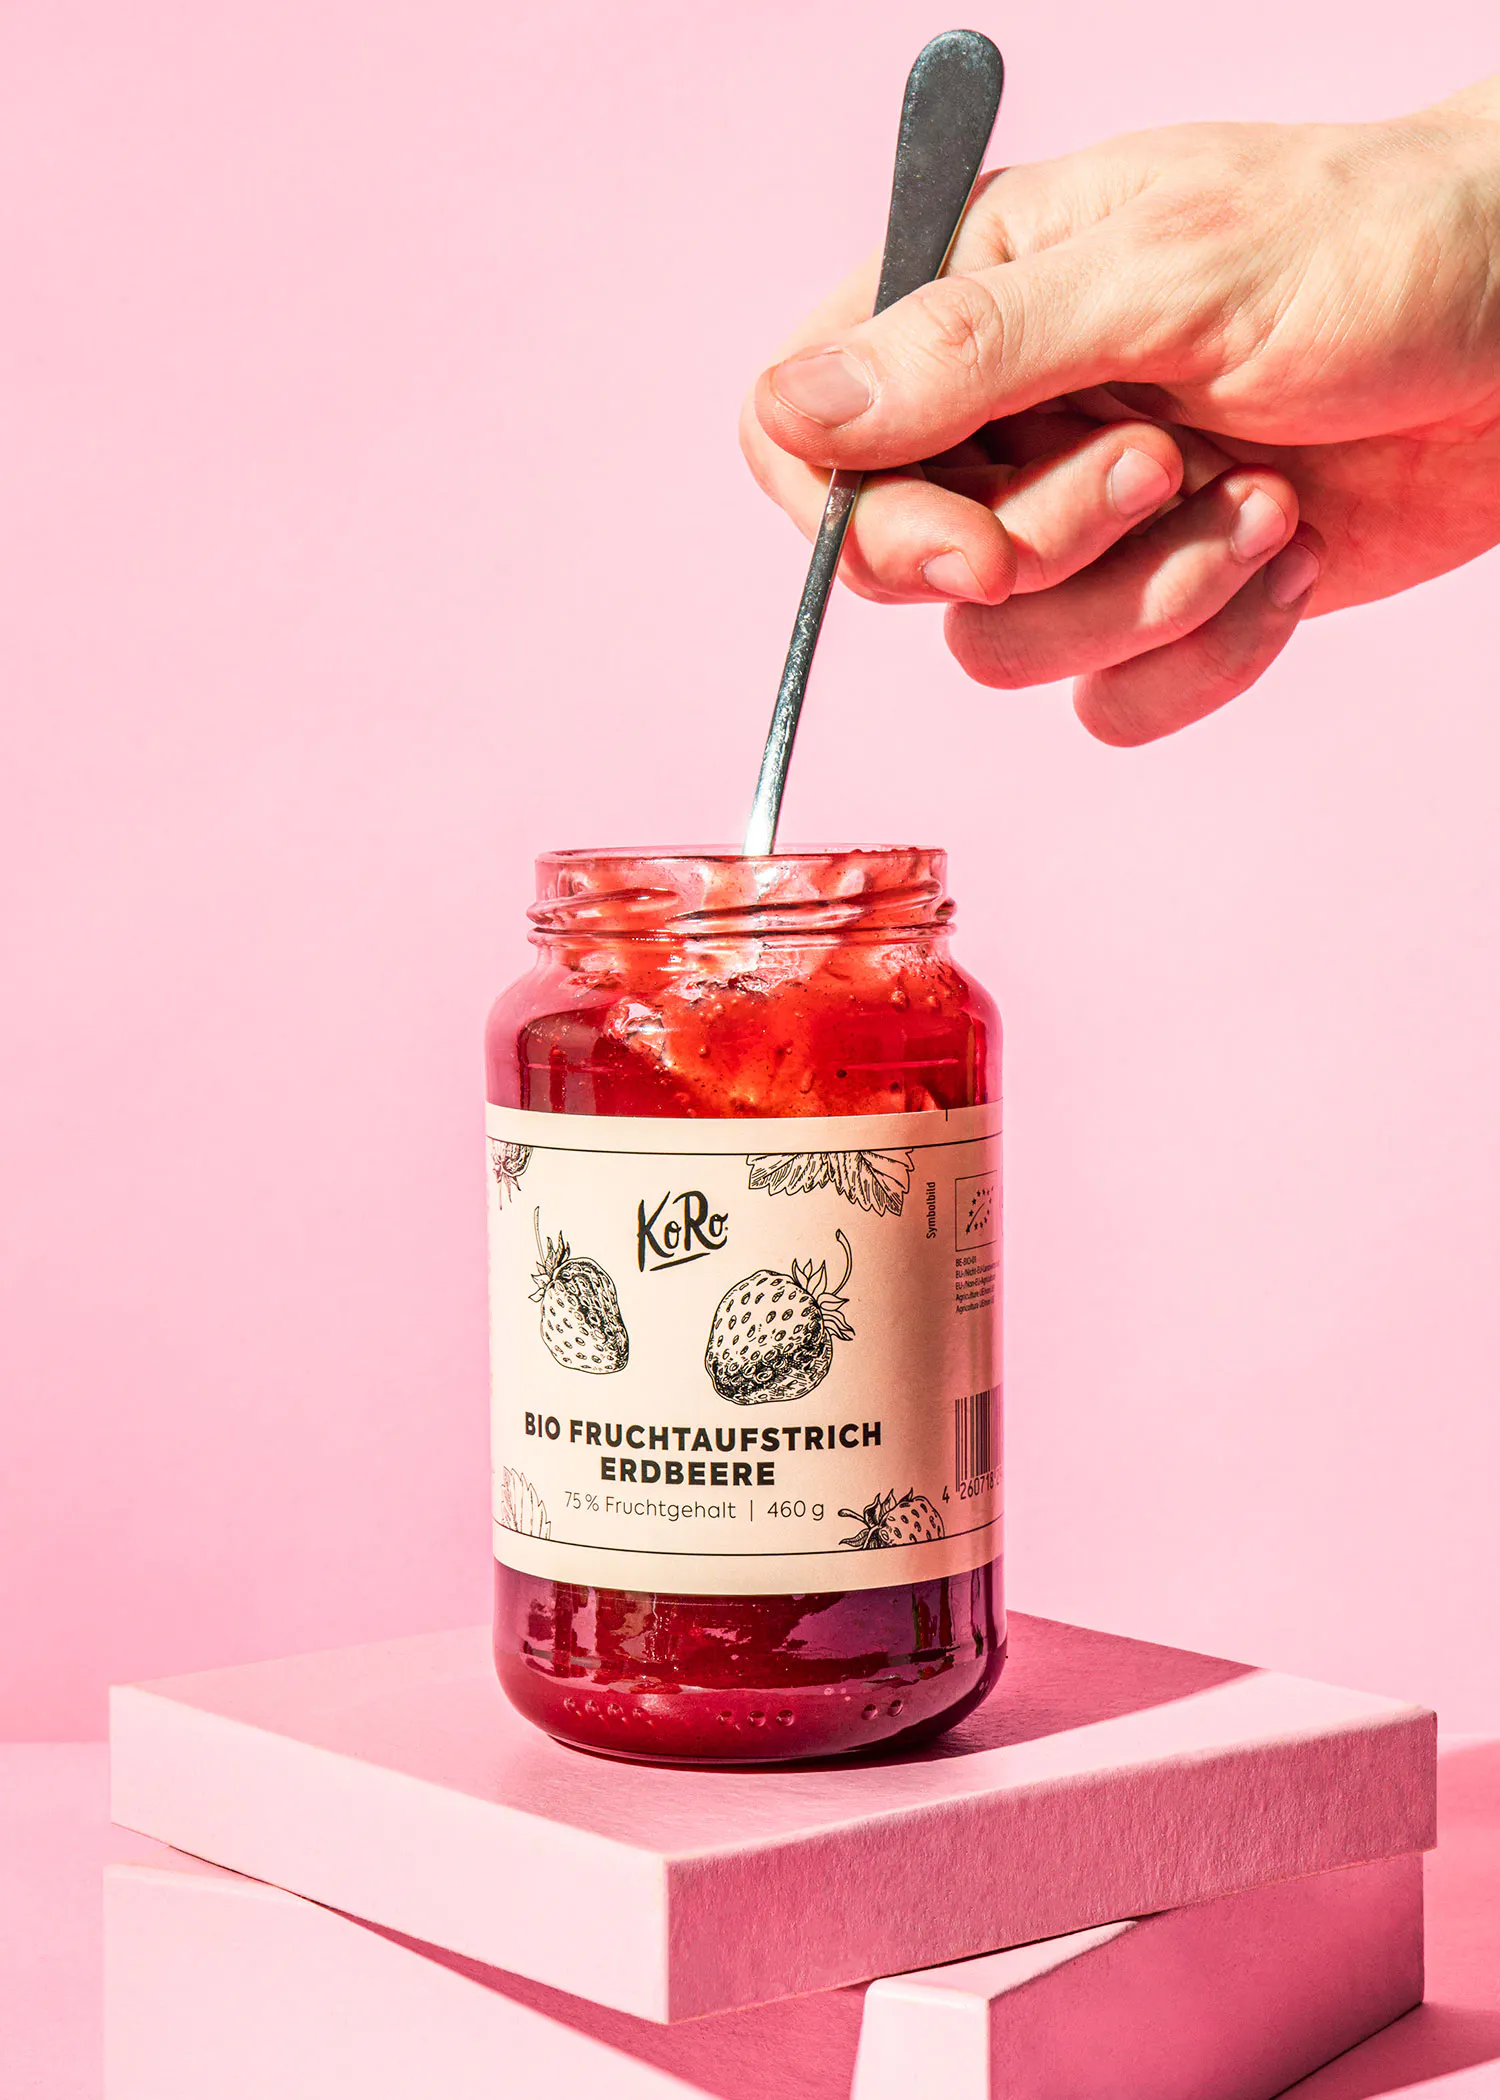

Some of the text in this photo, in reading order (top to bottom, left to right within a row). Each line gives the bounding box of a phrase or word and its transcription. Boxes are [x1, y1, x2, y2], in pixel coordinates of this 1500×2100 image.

[925, 1181, 938, 1239] Symbolbild
[525, 1411, 882, 1453] BIO FRUCHTAUFSTRICH
[600, 1456, 776, 1487] ERDBEERE
[564, 1490, 582, 1510] 75
[605, 1495, 737, 1523] Fruchtgehalt
[767, 1499, 807, 1518] 460
